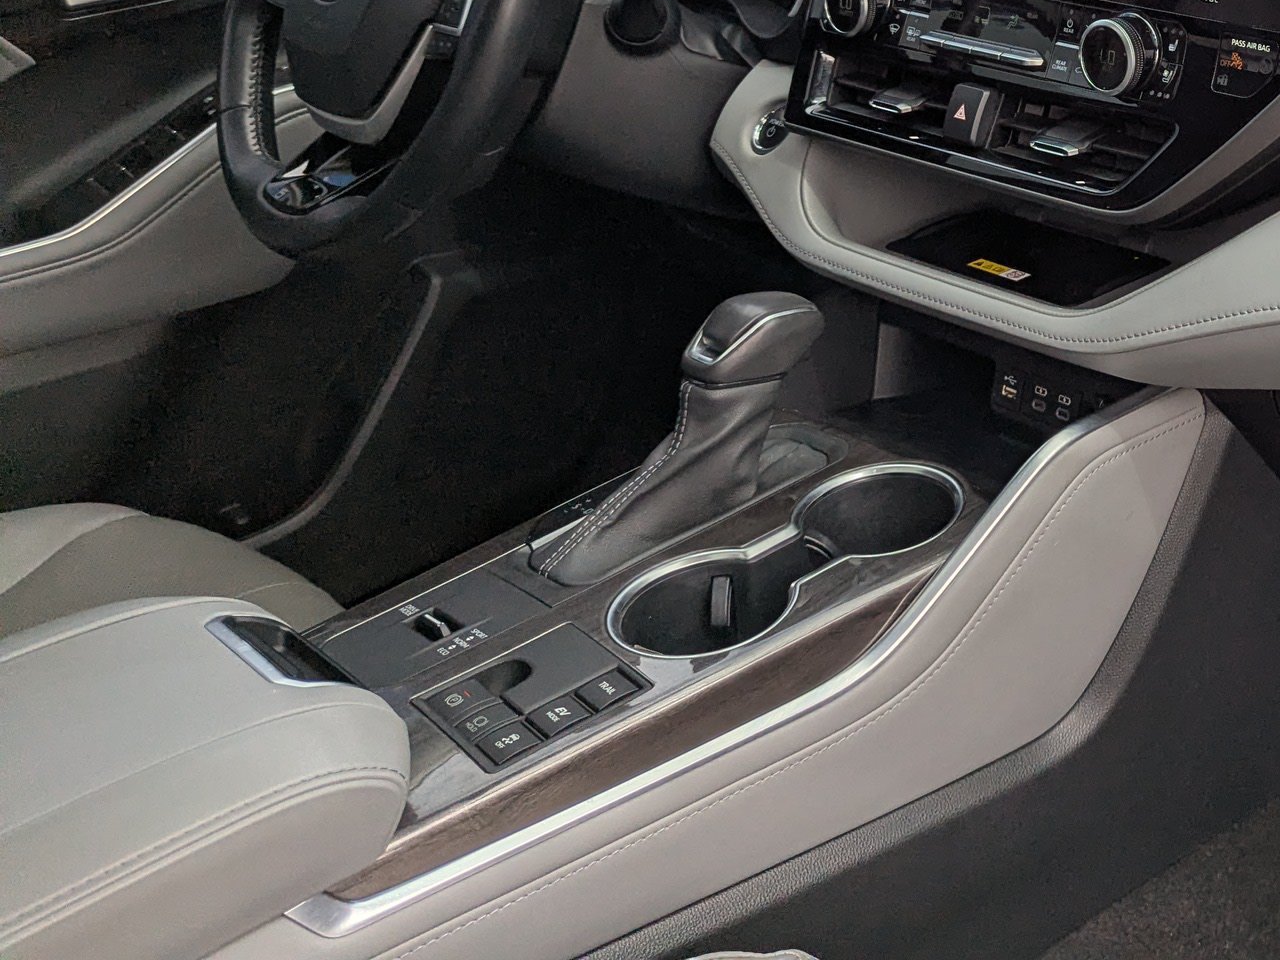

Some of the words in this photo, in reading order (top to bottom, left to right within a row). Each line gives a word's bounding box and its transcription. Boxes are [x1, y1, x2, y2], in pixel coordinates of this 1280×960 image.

[1231, 38, 1246, 48] PASS
[1246, 41, 1257, 50] AIR
[1257, 43, 1271, 52] BAG
[471, 628, 488, 639] SPORT
[453, 636, 470, 648] NORM
[437, 647, 450, 656] ECO
[598, 681, 616, 695] TRAIL
[554, 706, 572, 716] EV
[546, 711, 561, 723] MODE
[466, 722, 478, 732] HOLD
[495, 740, 505, 749] OFF
